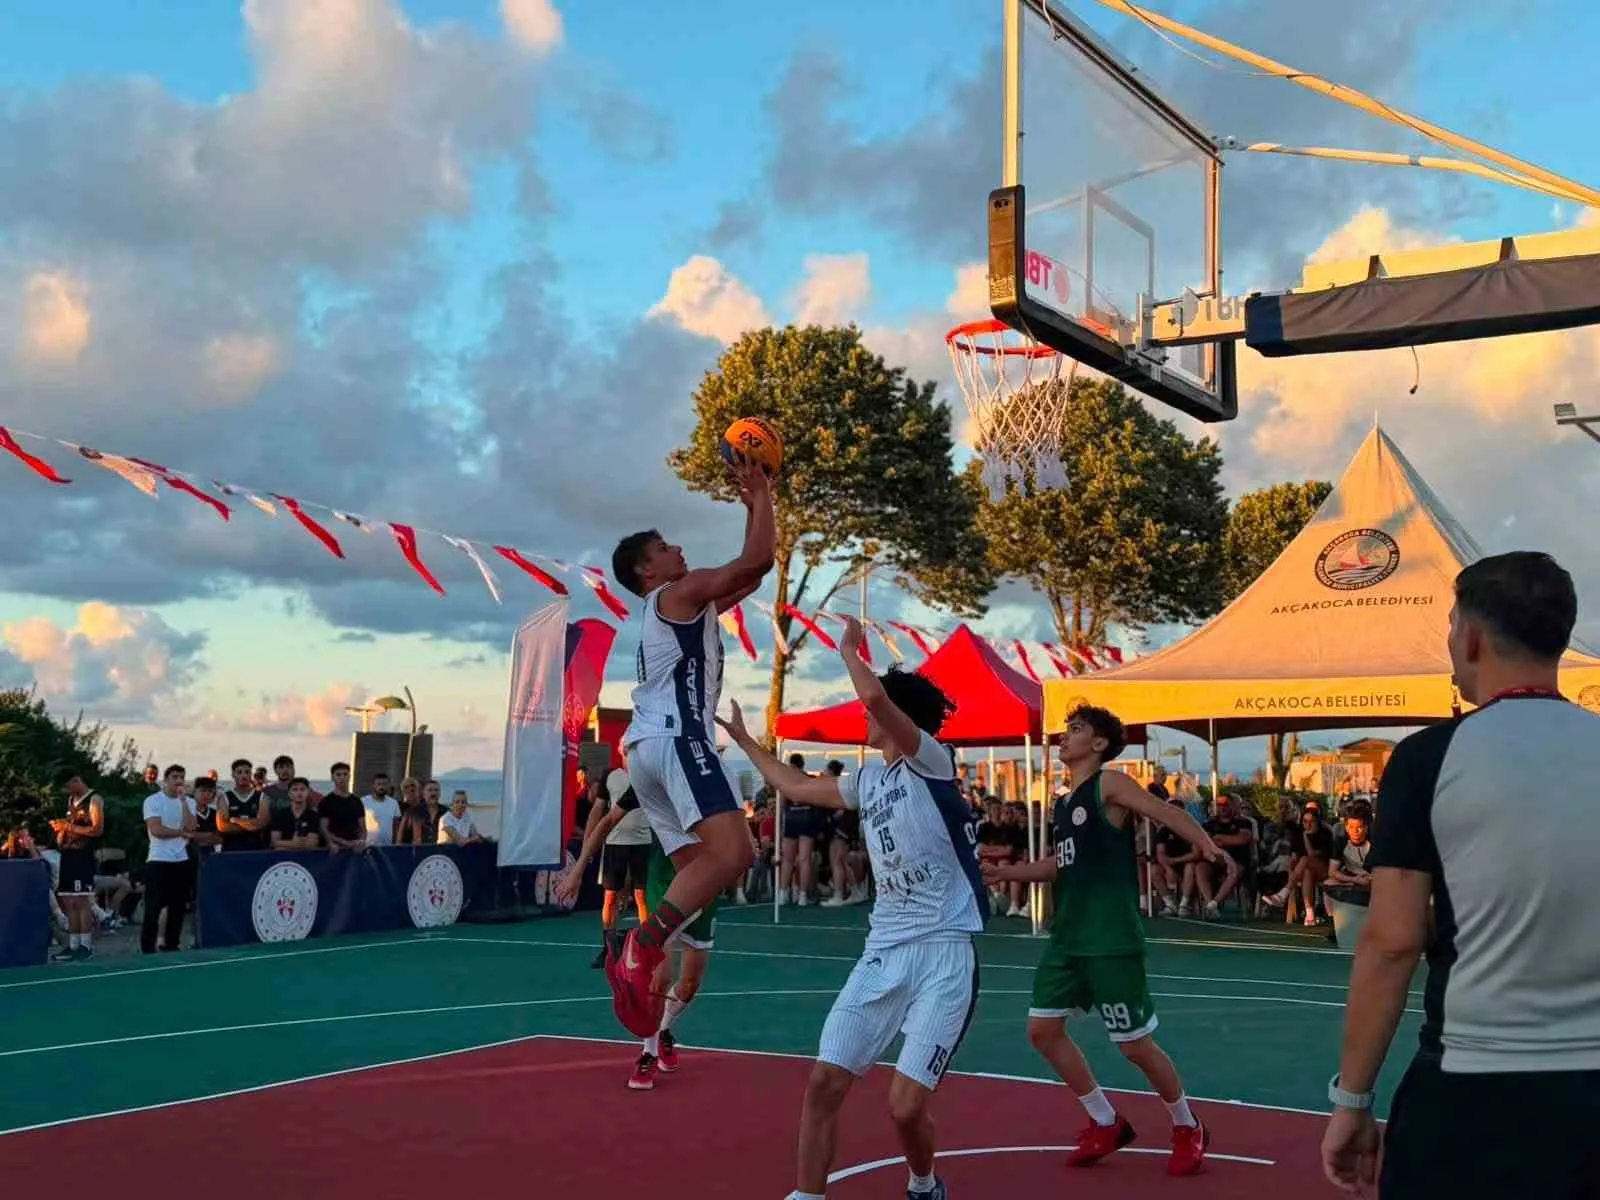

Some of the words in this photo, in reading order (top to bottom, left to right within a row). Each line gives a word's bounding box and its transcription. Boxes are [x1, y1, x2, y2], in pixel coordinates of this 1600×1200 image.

[1271, 599, 1353, 615] AKÇAKOCA
[1356, 595, 1433, 607] BELEDİYESİ
[1235, 696, 1322, 711] AKÇAKOCA
[1327, 692, 1406, 708] BELEDİYESİ
[688, 736, 712, 776] HE
[878, 826, 896, 855] 15
[1056, 836, 1076, 869] 99
[1102, 1002, 1132, 1030] 99
[926, 1044, 949, 1076] 15
